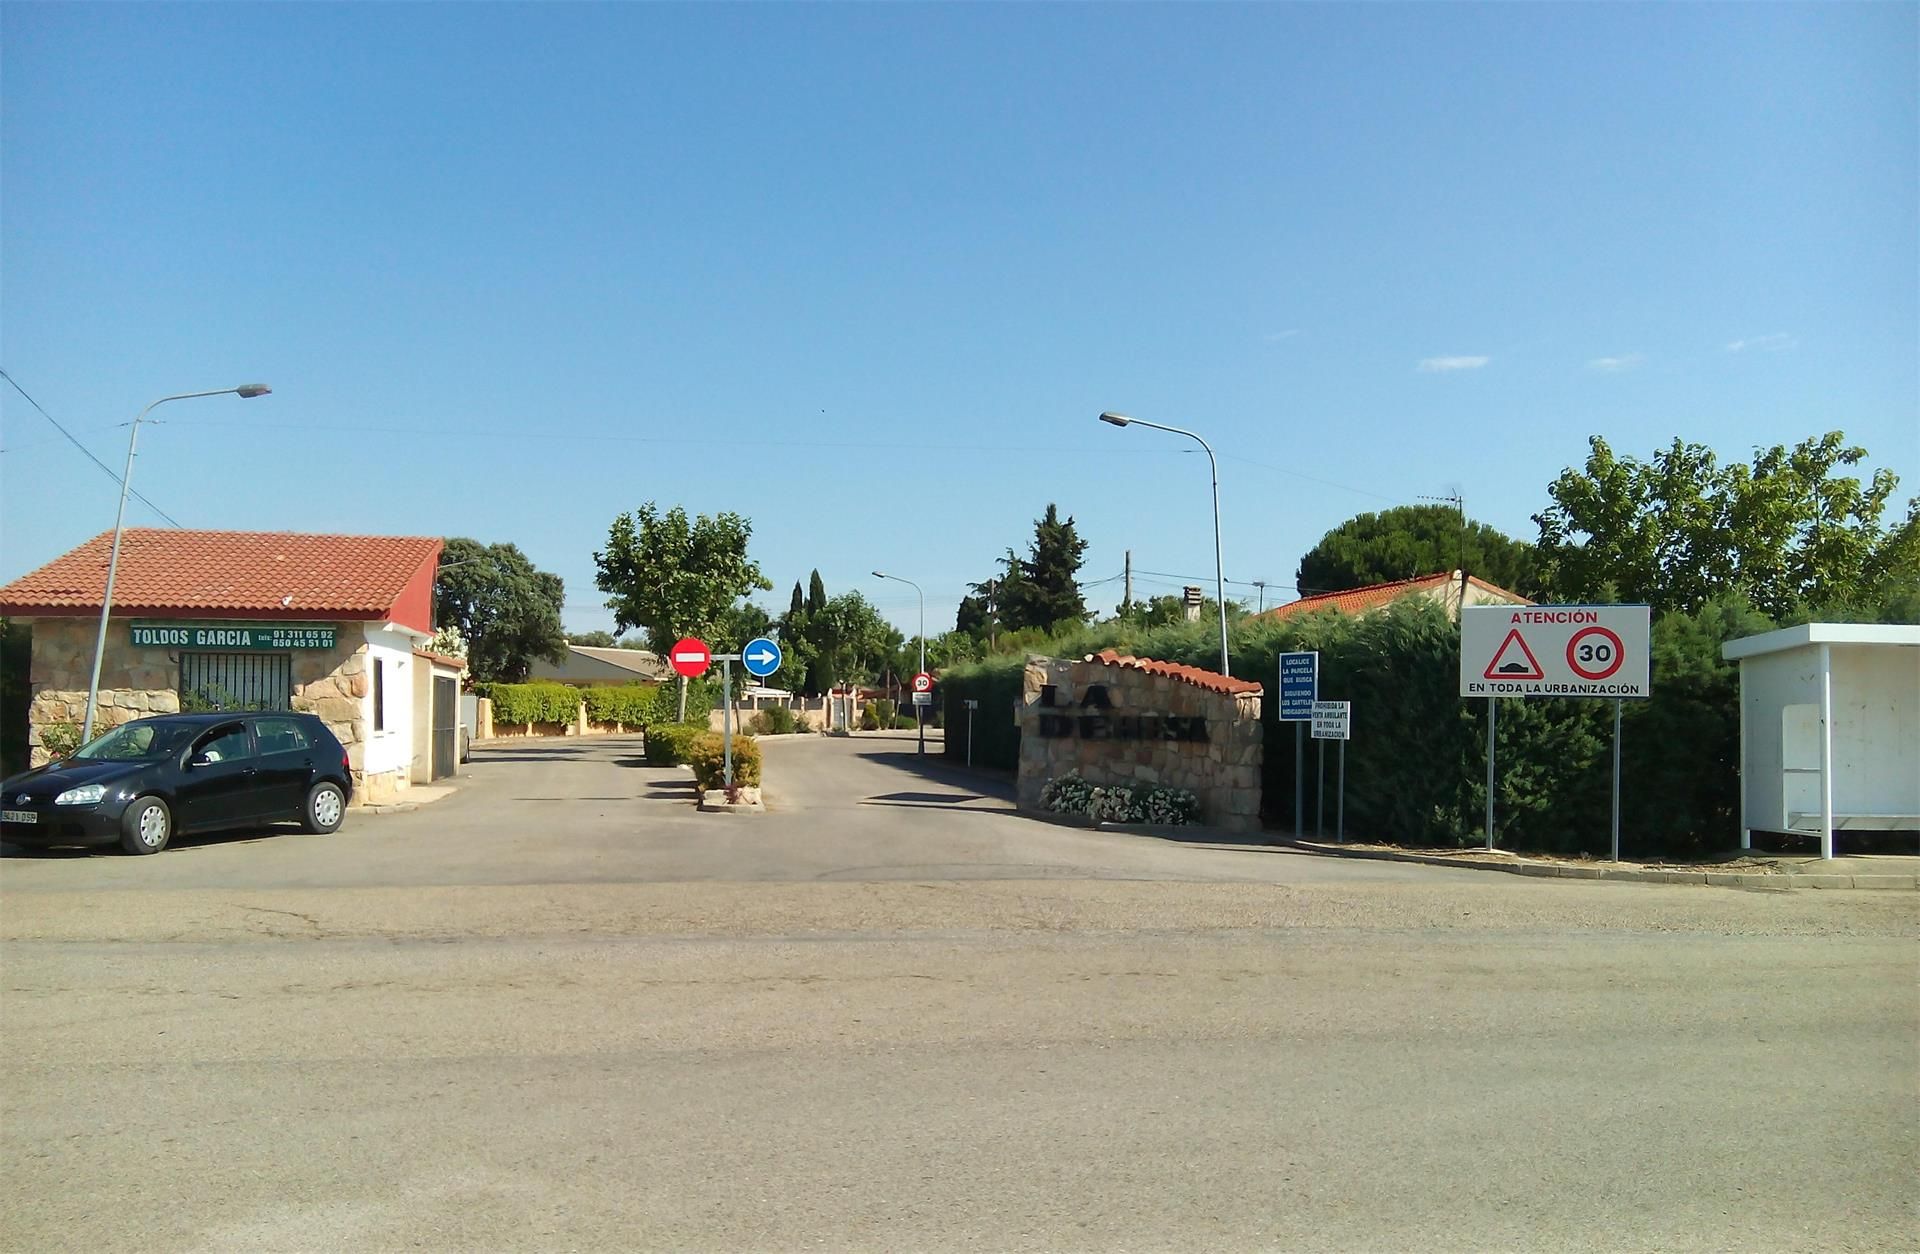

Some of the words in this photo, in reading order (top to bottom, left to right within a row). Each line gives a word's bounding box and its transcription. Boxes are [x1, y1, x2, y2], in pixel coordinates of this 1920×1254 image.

[1511, 609, 1597, 624] ATENCIÓN
[133, 629, 188, 644] TOLDOS
[196, 630, 251, 646] GARCIA
[273, 630, 284, 639] 91
[287, 630, 303, 639] 311
[306, 630, 318, 639] 65
[321, 630, 333, 639] 92
[272, 639, 291, 647] 650
[293, 639, 306, 647] 45
[308, 639, 319, 647] 51
[322, 639, 333, 648] 01
[1579, 644, 1610, 662] 30
[1286, 658, 1310, 666] LOCALICE
[917, 679, 928, 687] 30
[1469, 683, 1485, 692] EN
[1490, 683, 1523, 693] TODA
[1526, 683, 1541, 693] LA
[1545, 683, 1639, 694] URBANIZACIÓN
[1040, 685, 1114, 708] LA
[1312, 711, 1323, 719] VENTA
[1324, 711, 1347, 719] AMBULANTE
